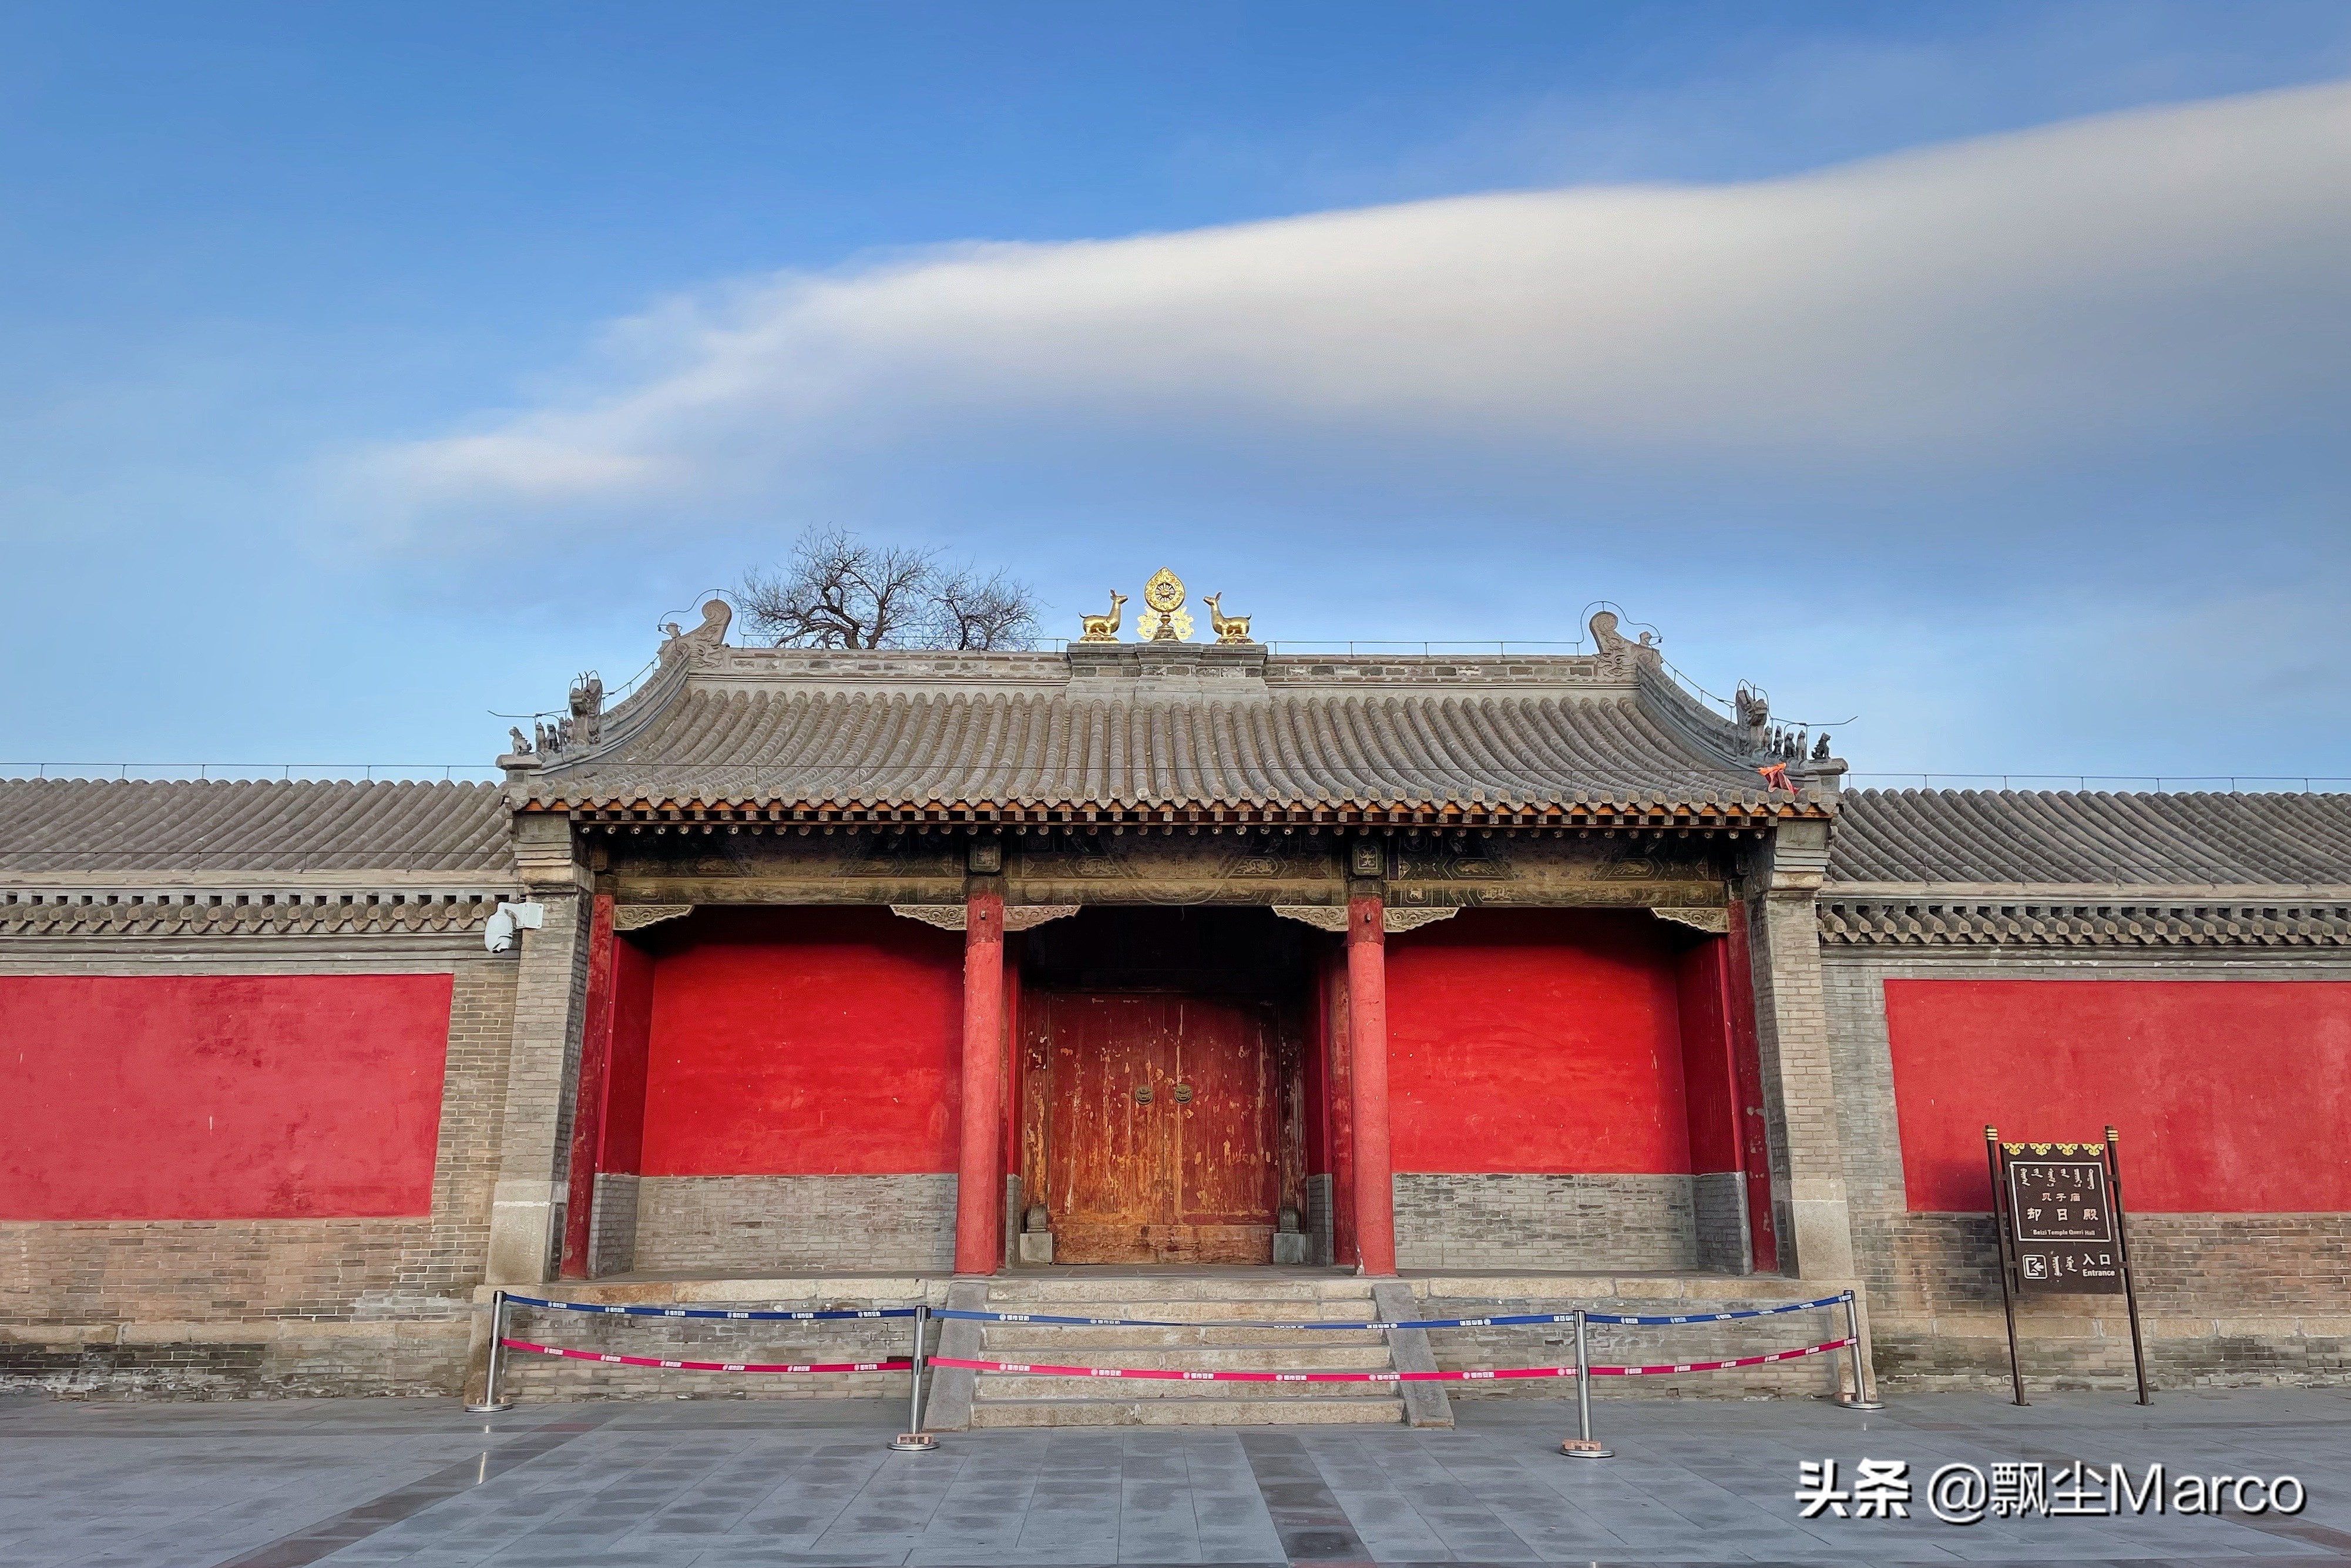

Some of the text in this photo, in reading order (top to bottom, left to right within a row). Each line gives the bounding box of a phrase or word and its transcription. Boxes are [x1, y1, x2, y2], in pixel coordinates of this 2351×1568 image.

[2041, 1193, 2081, 1202] 贝子庙
[2027, 1207, 2099, 1221] 却日殿
[2083, 1253, 2111, 1265] 入口
[2082, 1268, 2115, 1277] Entrance
